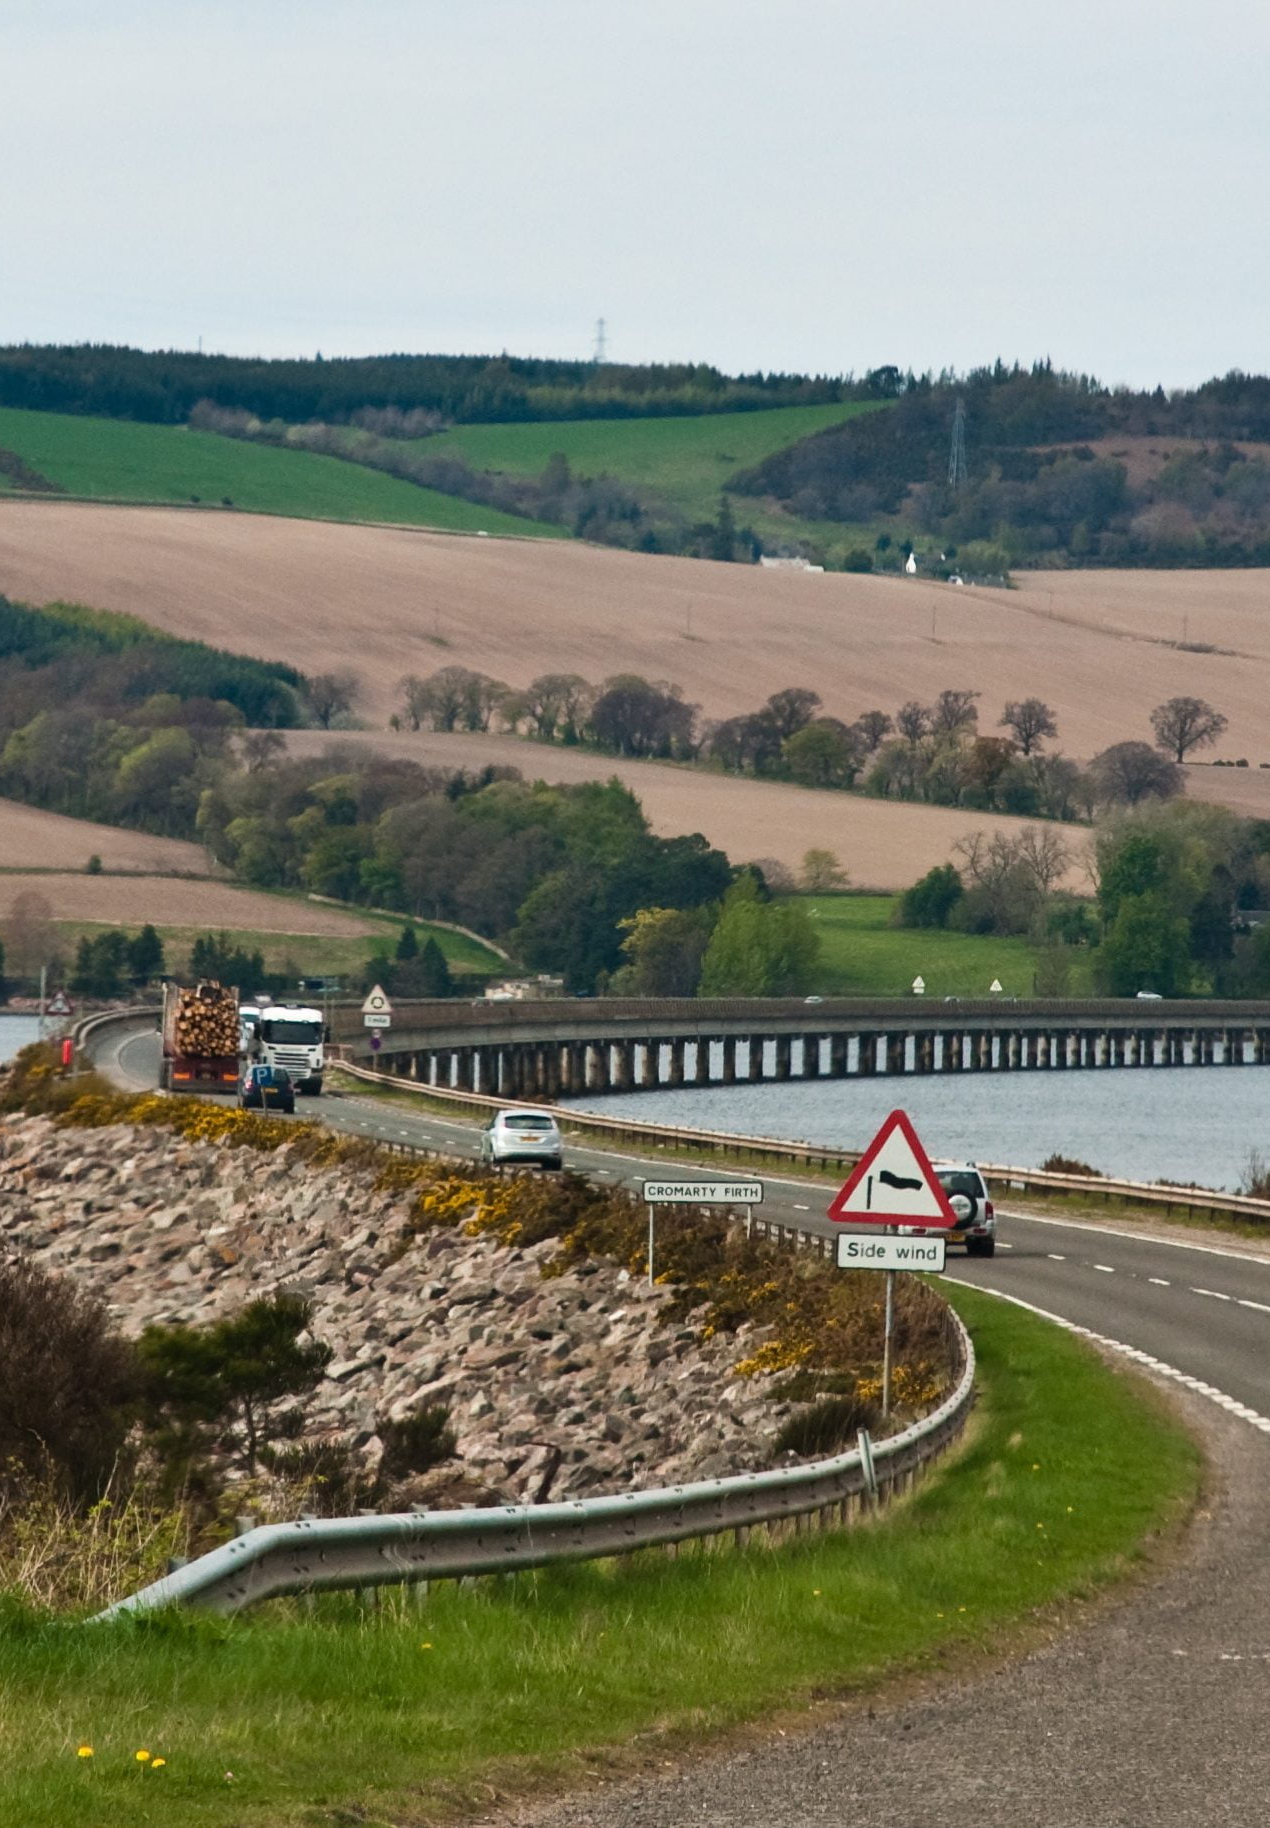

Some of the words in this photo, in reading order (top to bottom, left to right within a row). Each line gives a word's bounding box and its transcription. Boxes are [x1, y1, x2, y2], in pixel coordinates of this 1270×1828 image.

[257, 1068, 268, 1084] P
[648, 1186, 716, 1197] CROMARTY
[724, 1187, 758, 1197] FIRTH
[847, 1242, 886, 1258] Side
[896, 1245, 937, 1261] wind
